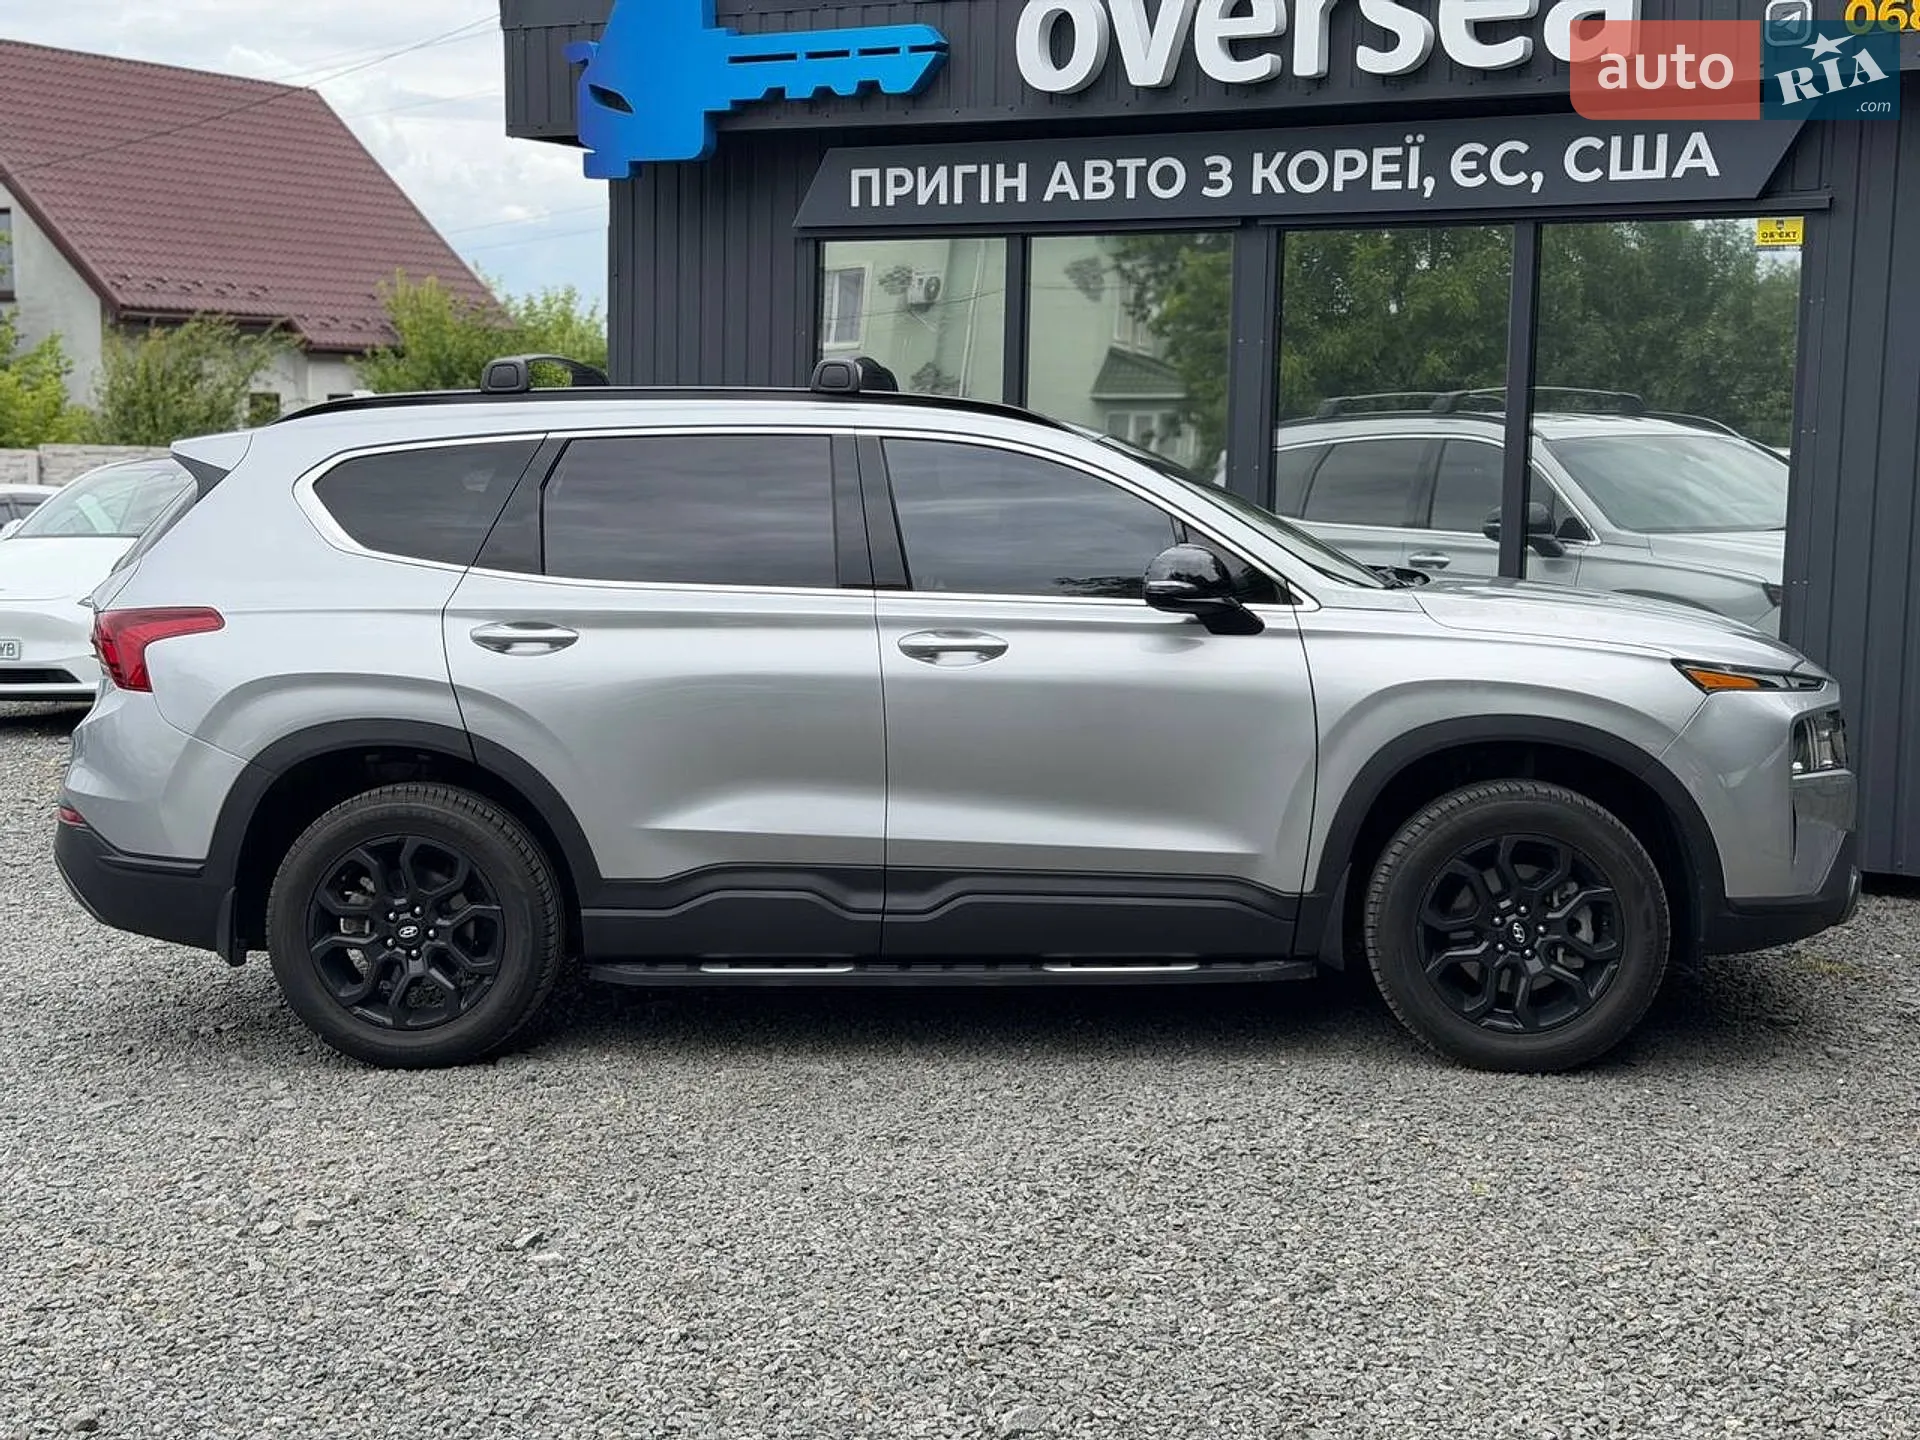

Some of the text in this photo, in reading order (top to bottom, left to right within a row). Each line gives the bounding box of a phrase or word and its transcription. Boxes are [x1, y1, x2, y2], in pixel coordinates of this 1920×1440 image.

[850, 162, 1028, 207] ПРИГІН
[1042, 156, 1187, 202] АВТО
[1251, 133, 1436, 198] КОРЕЇ,
[1450, 140, 1545, 194] ЄС,
[1563, 131, 1720, 182] США
